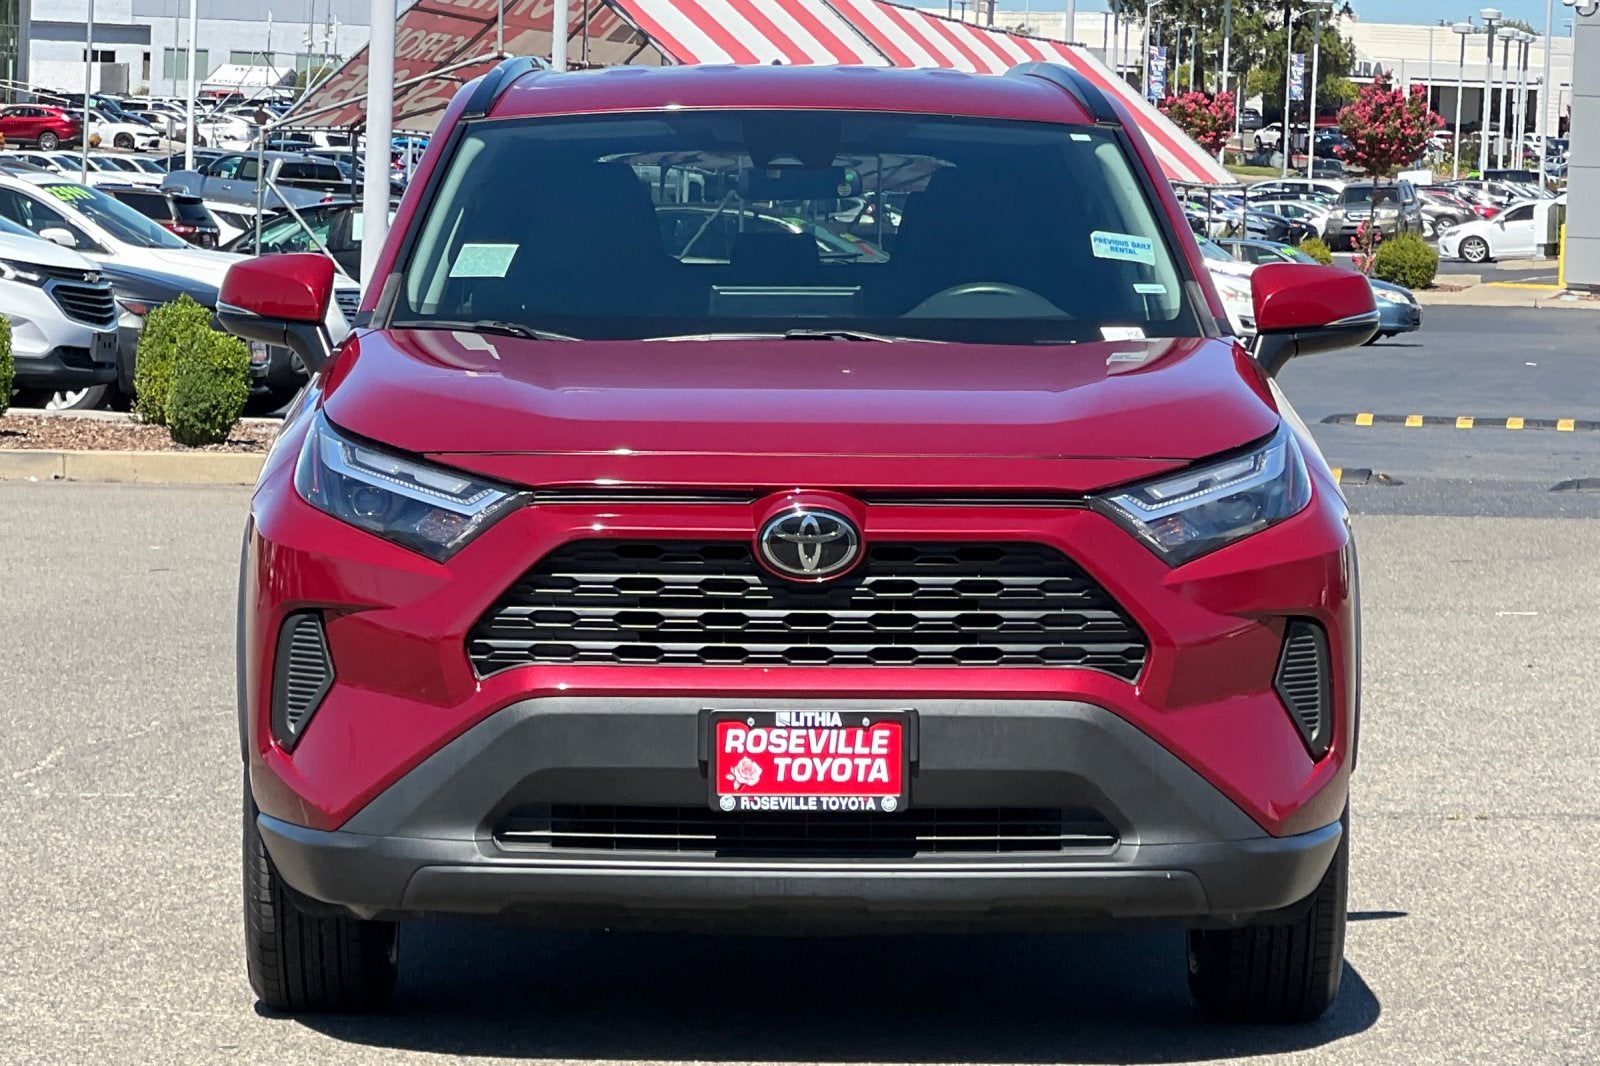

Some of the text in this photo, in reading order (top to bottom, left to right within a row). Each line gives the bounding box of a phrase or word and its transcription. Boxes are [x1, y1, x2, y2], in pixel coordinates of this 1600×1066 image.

[1093, 237, 1151, 250] PREVIOUS DAILY
[1109, 245, 1138, 255] RENTAL
[790, 711, 842, 727] LITHIA
[724, 728, 891, 755] ROSEVILLE
[773, 756, 889, 783] TOYOTA
[740, 796, 876, 811] ROSEVILLE TOYOTA
